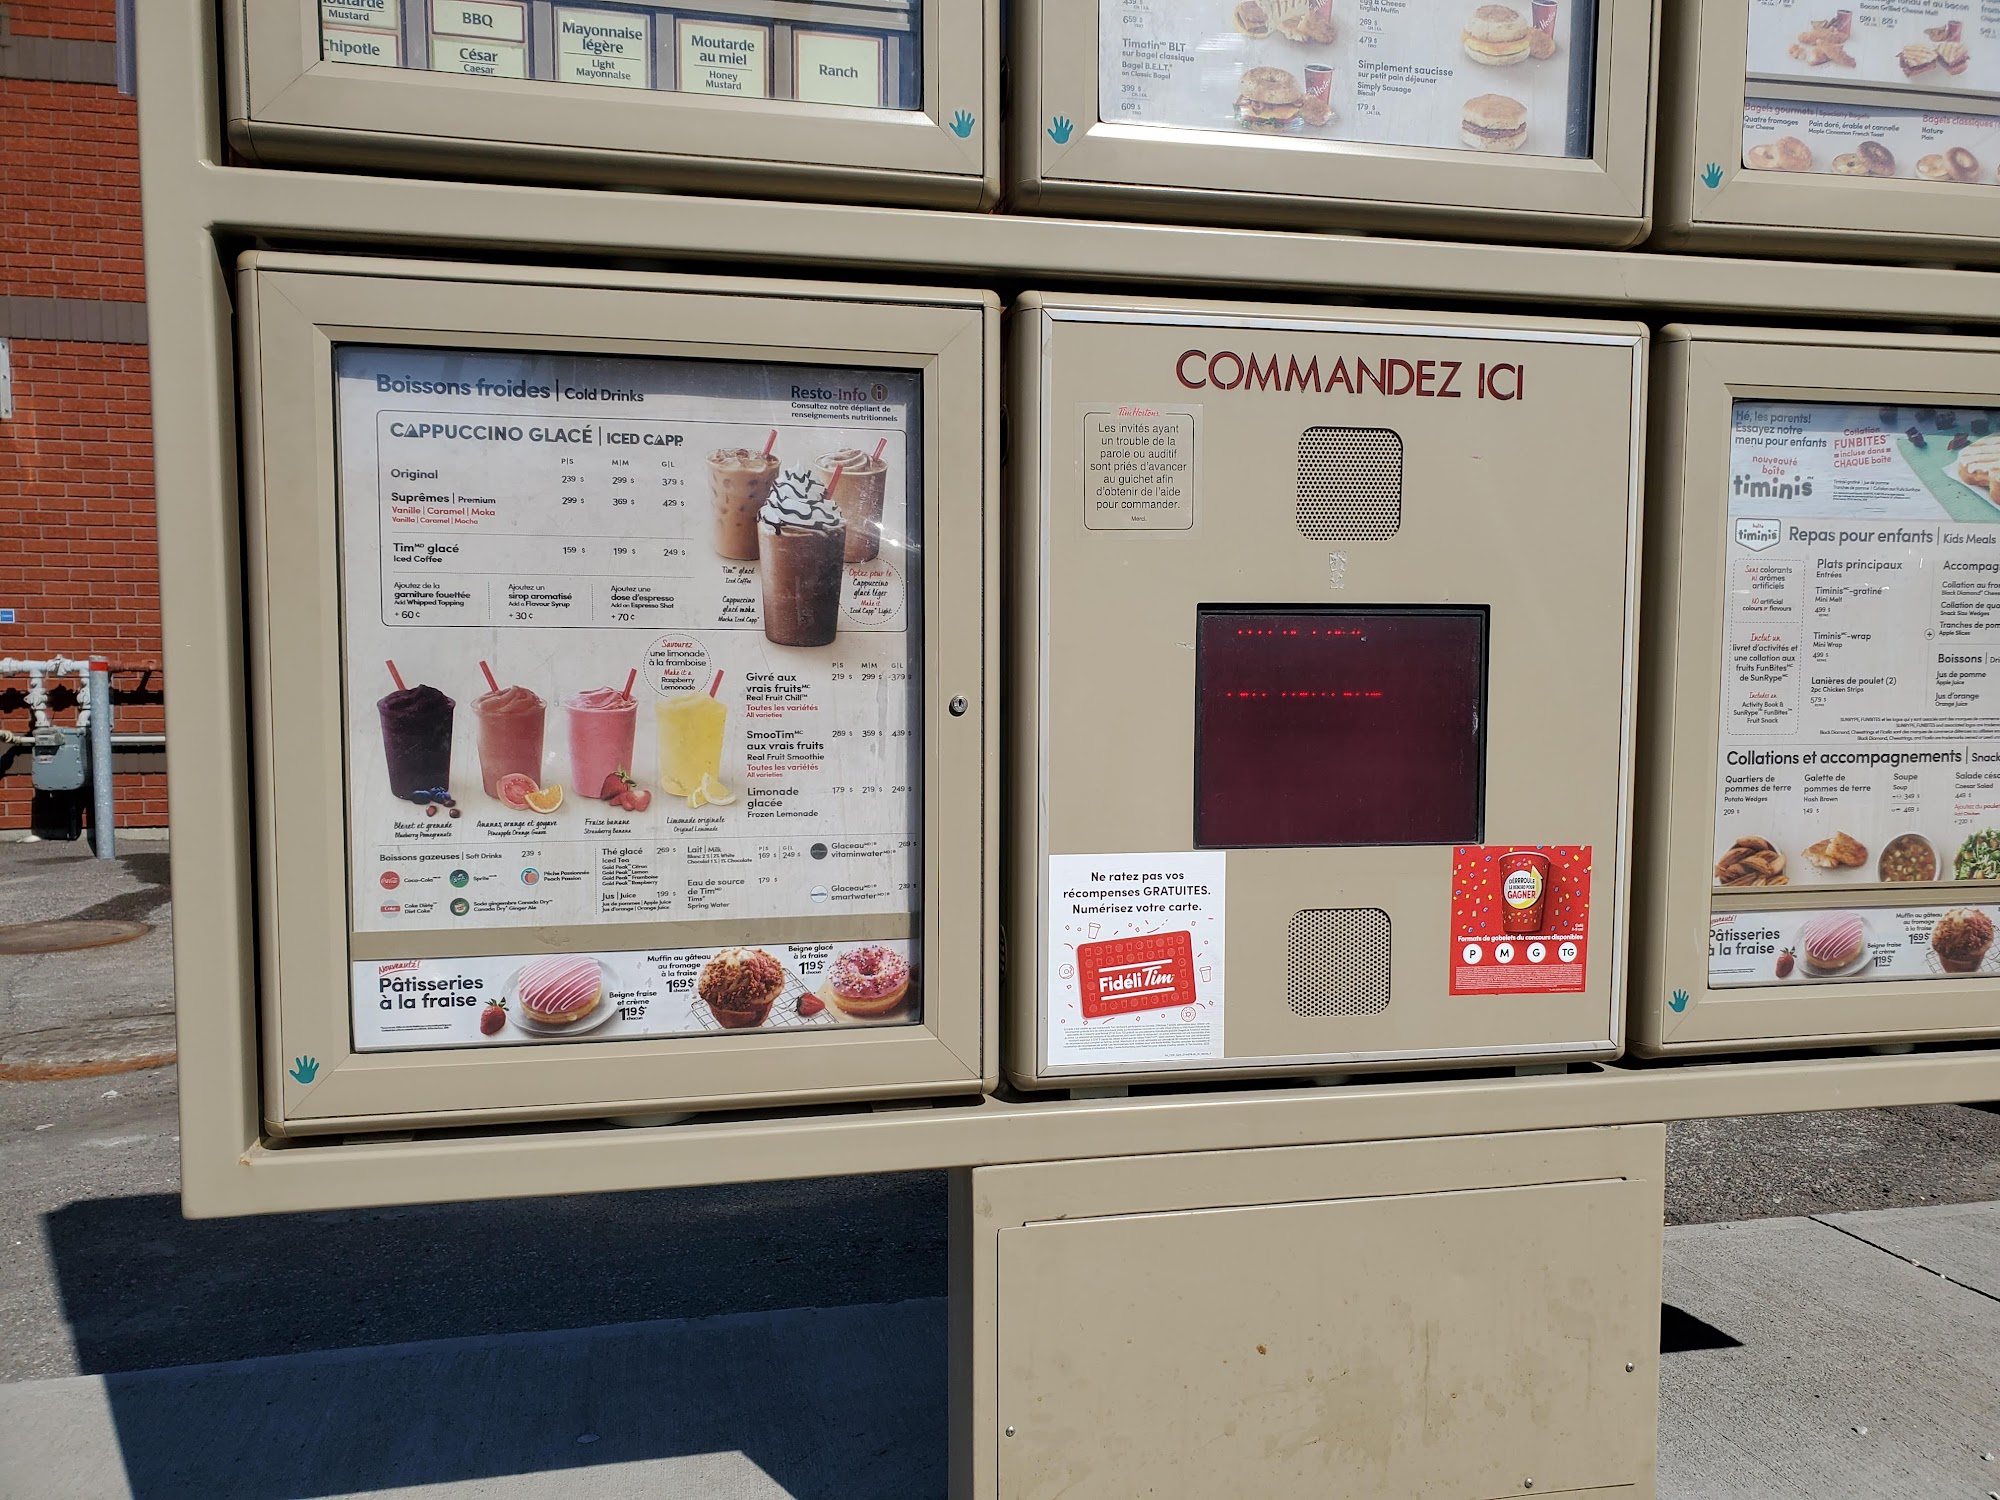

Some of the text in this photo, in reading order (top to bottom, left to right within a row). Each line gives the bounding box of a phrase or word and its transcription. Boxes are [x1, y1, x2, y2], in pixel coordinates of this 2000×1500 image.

[328, 8, 370, 21] Mustard
[462, 12, 493, 28] BBQ
[562, 21, 643, 44] Mayonnaise
[582, 37, 623, 54] légère
[691, 34, 755, 52] Moutarde
[459, 47, 498, 62] César
[699, 51, 747, 66] au miel
[463, 63, 495, 75] Caesar
[819, 63, 858, 79] Ranch
[1358, 59, 1454, 77] Simplement saucisse
[575, 67, 631, 82] Mayonnaise
[709, 70, 738, 82] Honey
[1369, 71, 1386, 82] petit
[1388, 73, 1404, 83] pain
[1405, 74, 1437, 85] déjeuner
[705, 79, 742, 91] Mustard
[1357, 82, 1412, 94] Simply Sausage
[1744, 115, 1799, 127] Quatre fromages
[1921, 127, 1944, 135] Nature
[1176, 349, 1524, 401] COMMANDEZ ICI
[376, 373, 644, 402] Boissons froides Cold Drinks
[791, 385, 868, 401] Resto-Info
[791, 401, 891, 414] Consultez notre dépliant de
[791, 412, 898, 423] renseignements nutritionnels
[1736, 410, 1812, 425] Hé, les parents!
[390, 422, 523, 442] CAPPUCCINO
[529, 425, 593, 444] GLACÉ
[606, 432, 640, 445] ICED
[1098, 422, 1179, 435] Les invités ayant
[1735, 423, 1803, 435] Essayez notre
[1101, 436, 1176, 446] un trouble de la
[1735, 436, 1827, 448] menu pour enfants
[1100, 449, 1131, 460] parole
[1148, 449, 1177, 459] auditif
[1090, 461, 1187, 473] sont priés d'avancer
[1752, 456, 1798, 466] nouveauté
[390, 468, 438, 482] Original
[1762, 465, 1786, 476] boîte
[1103, 474, 1174, 486] au guichet afin
[1096, 487, 1181, 497] d'obtenir de l'aide
[1733, 474, 1813, 500] timinis
[391, 492, 496, 505] Suprêmes Premium
[392, 506, 496, 516] Vanille Caramel Moka
[1096, 500, 1180, 511] pour commander.
[1789, 526, 1997, 545] Repas pour enfants Kids Meals
[1816, 559, 1903, 571] Plats principaux
[1816, 571, 1842, 579] Entrées
[508, 584, 535, 592] Ajoutez
[508, 592, 572, 602] sirop aromatisé
[666, 649, 705, 658] limonade
[648, 659, 707, 667] à la framboise
[746, 672, 775, 682] Givré
[768, 742, 795, 750] vrais
[796, 741, 824, 750] fruits
[786, 753, 825, 761] Smoothie
[1726, 749, 1962, 768] Collations et accompagnements
[1725, 774, 1776, 785] Quartiers de
[747, 787, 799, 797] Limonade
[1724, 783, 1792, 794] pommes de terre
[747, 798, 783, 810] glacée
[776, 810, 819, 818] Lemonade
[379, 853, 418, 862] Boissons
[419, 853, 460, 862] gazeuses
[465, 852, 481, 860] Soft
[1091, 872, 1185, 883] Ne ratez pas vos
[1063, 885, 1211, 900] récompenses GRATUITES.
[1507, 890, 1536, 899] GAGNER
[1072, 902, 1202, 914] Numérisez votre carte.
[1469, 948, 1575, 958] P M G TG
[379, 974, 484, 993] Pâtisseries
[379, 992, 478, 1010] à la fraise
